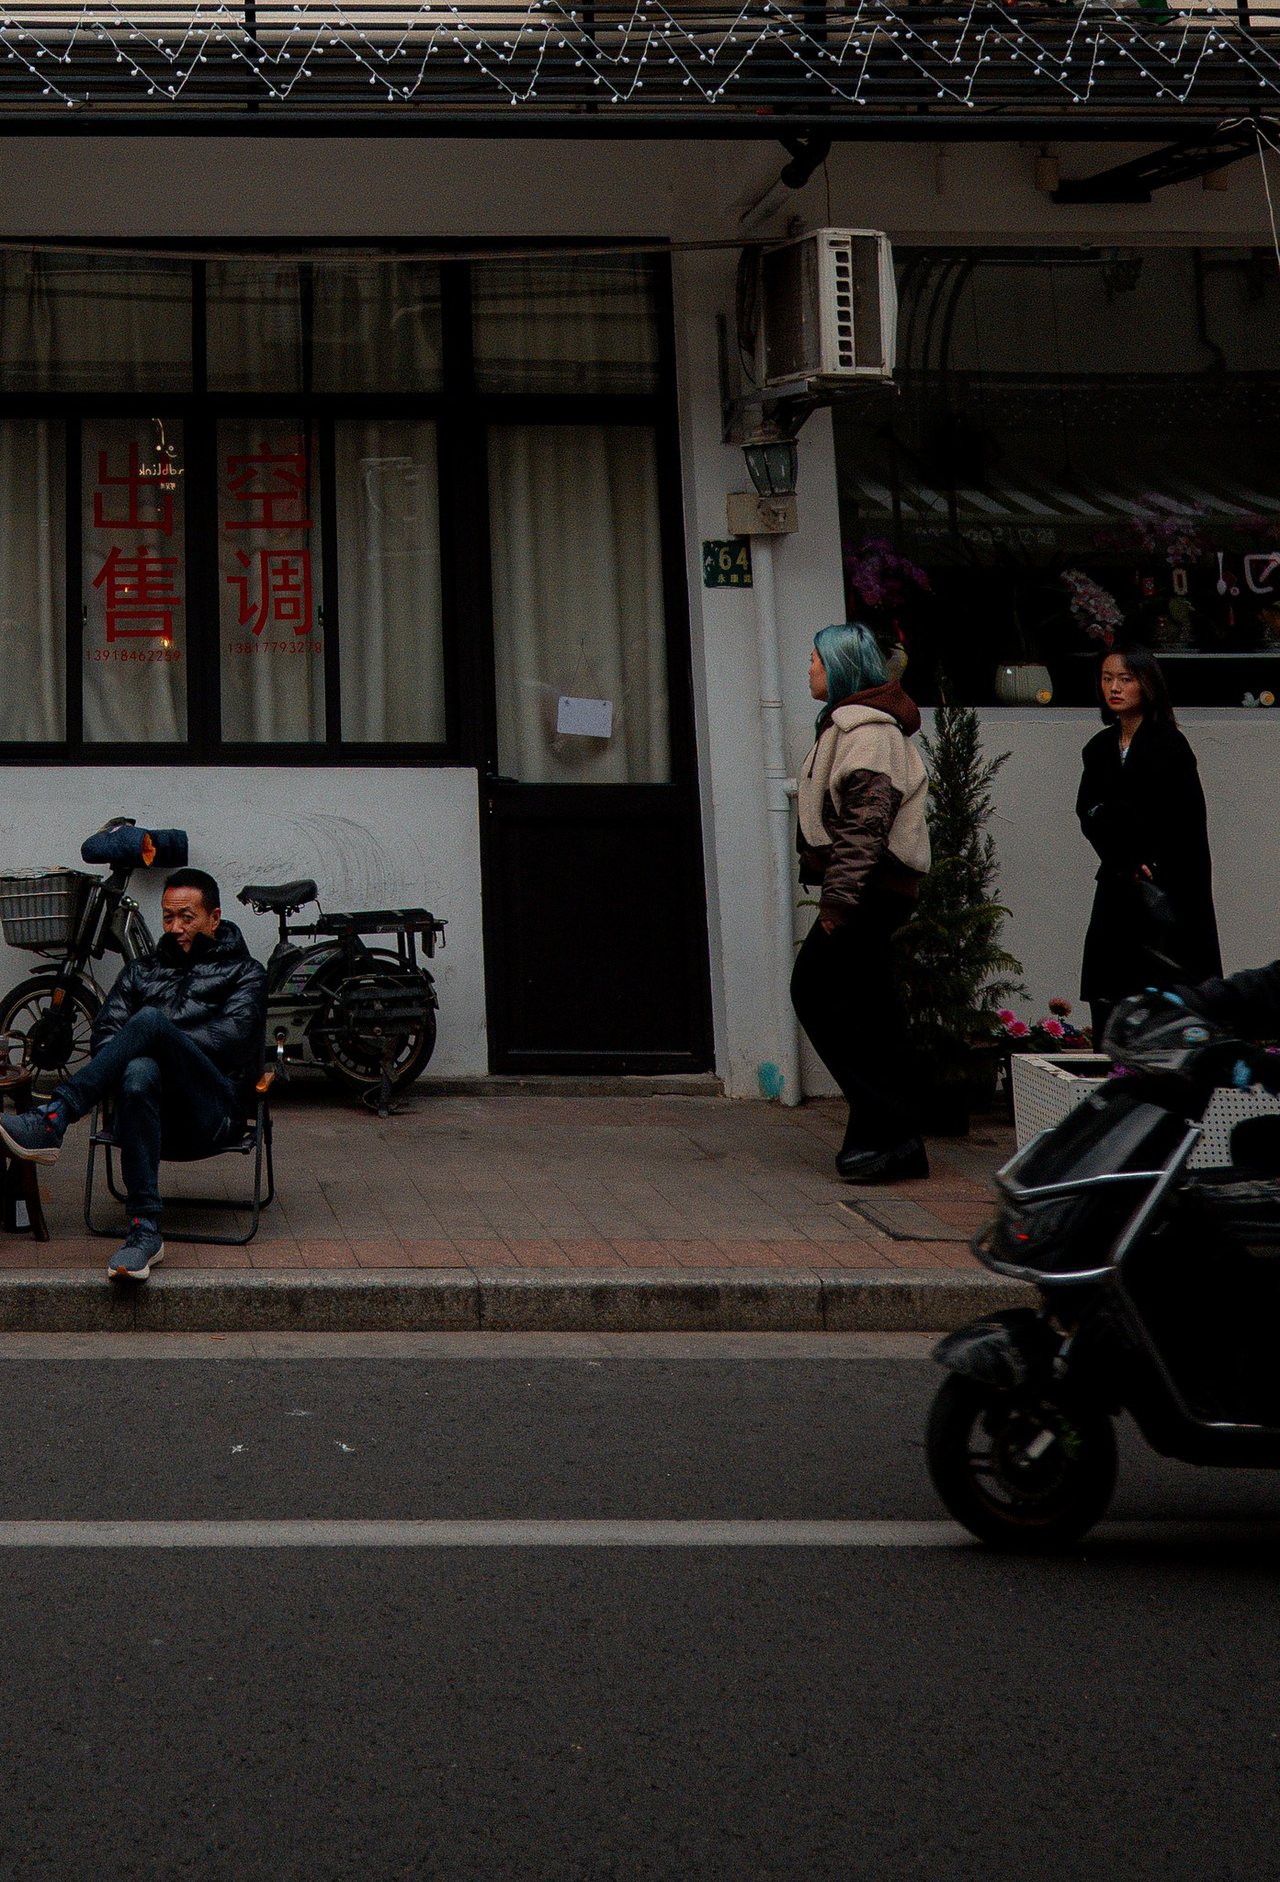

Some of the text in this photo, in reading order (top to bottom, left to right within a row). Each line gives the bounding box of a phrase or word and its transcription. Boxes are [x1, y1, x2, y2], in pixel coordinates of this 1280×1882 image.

[93, 442, 181, 642] 出售
[225, 442, 313, 636] 空调
[719, 547, 749, 571] 64
[85, 649, 181, 662] 13918462259
[228, 641, 322, 654] 13817793278
